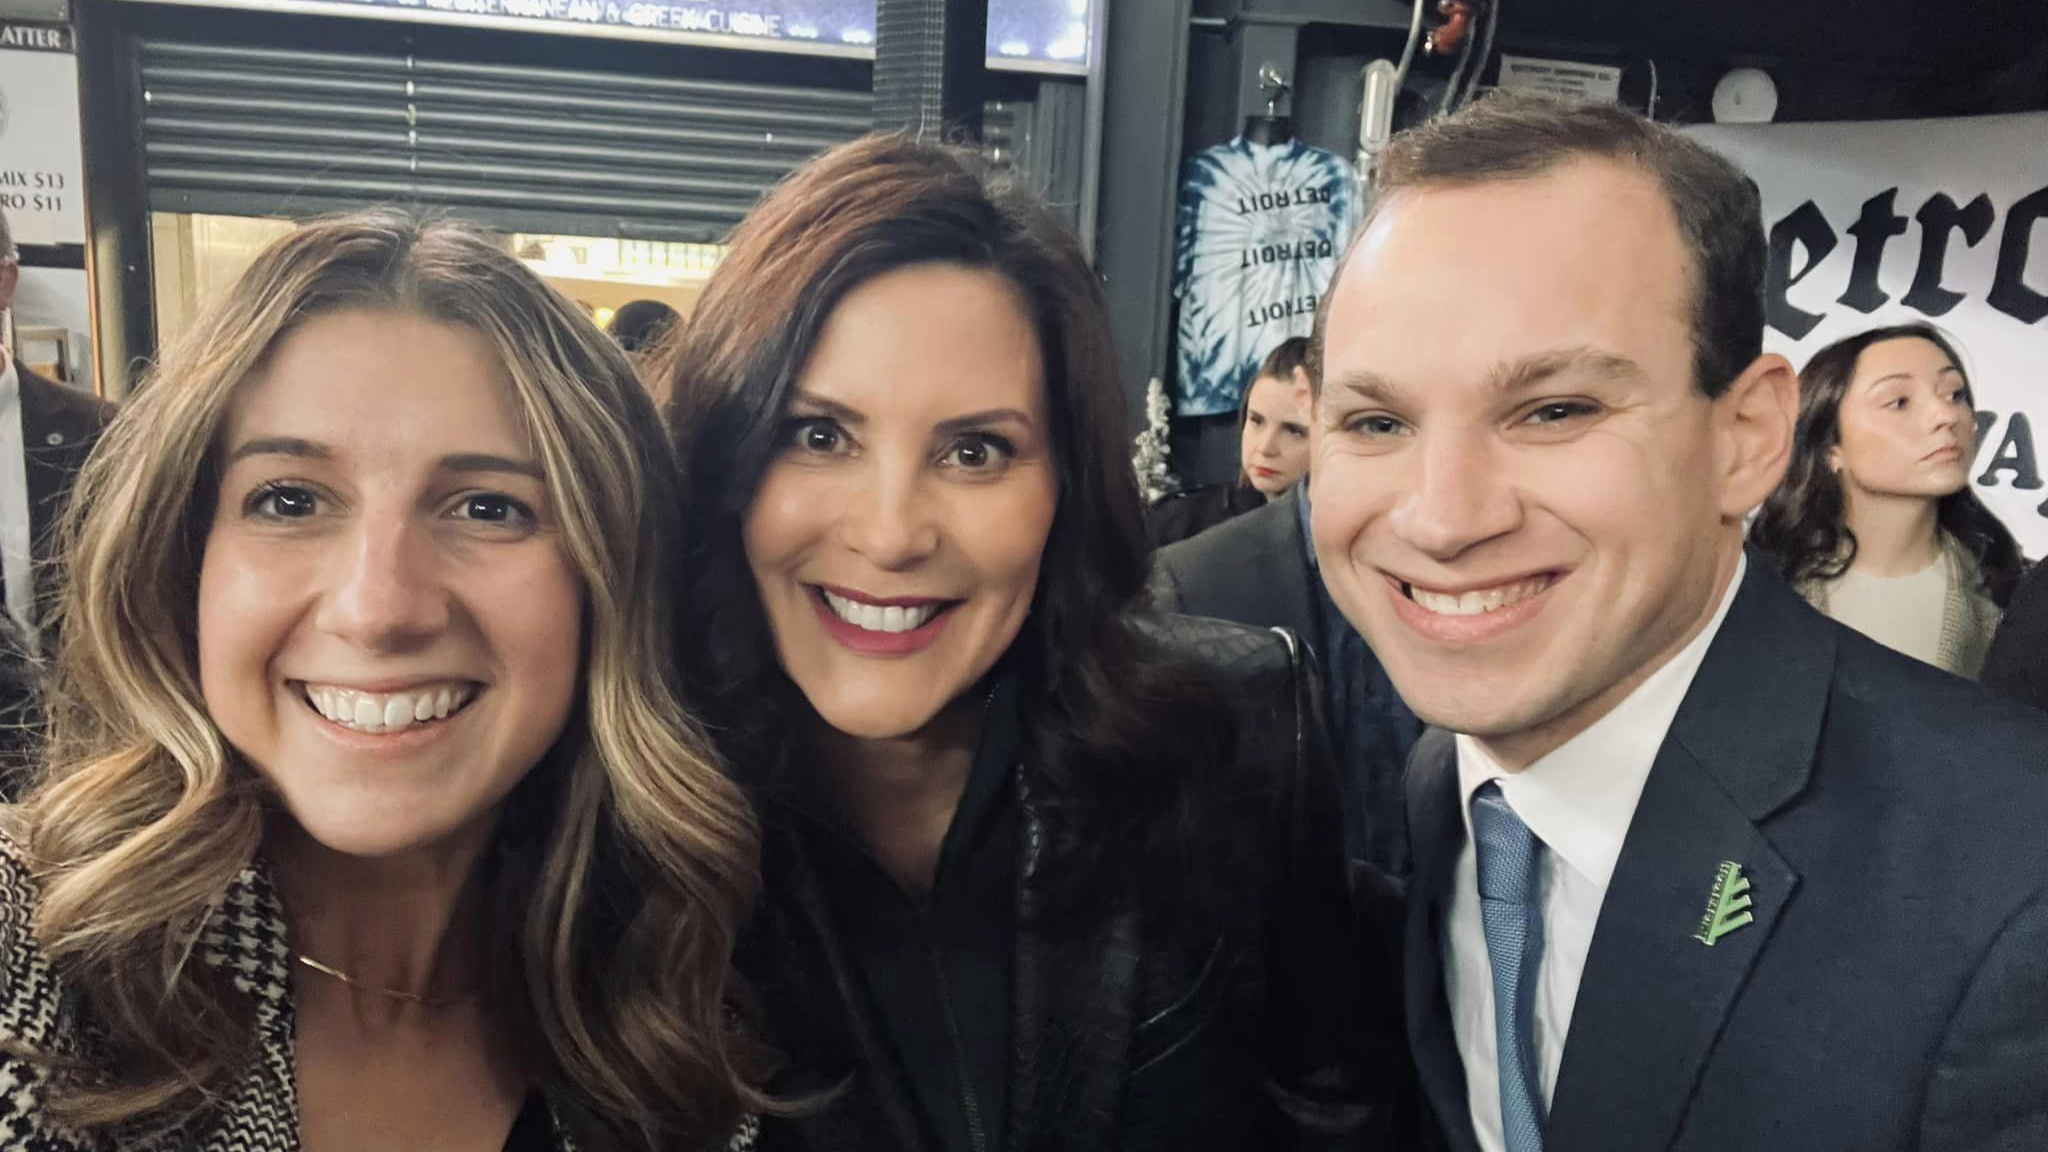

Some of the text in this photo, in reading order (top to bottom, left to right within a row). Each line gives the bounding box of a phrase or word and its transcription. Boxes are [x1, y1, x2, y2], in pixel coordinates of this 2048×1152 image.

[627, 4, 697, 30] GREEK
[704, 10, 781, 37] CUISINE
[1238, 186, 1332, 215] DETROIT
[1239, 239, 1332, 269] DETROIT
